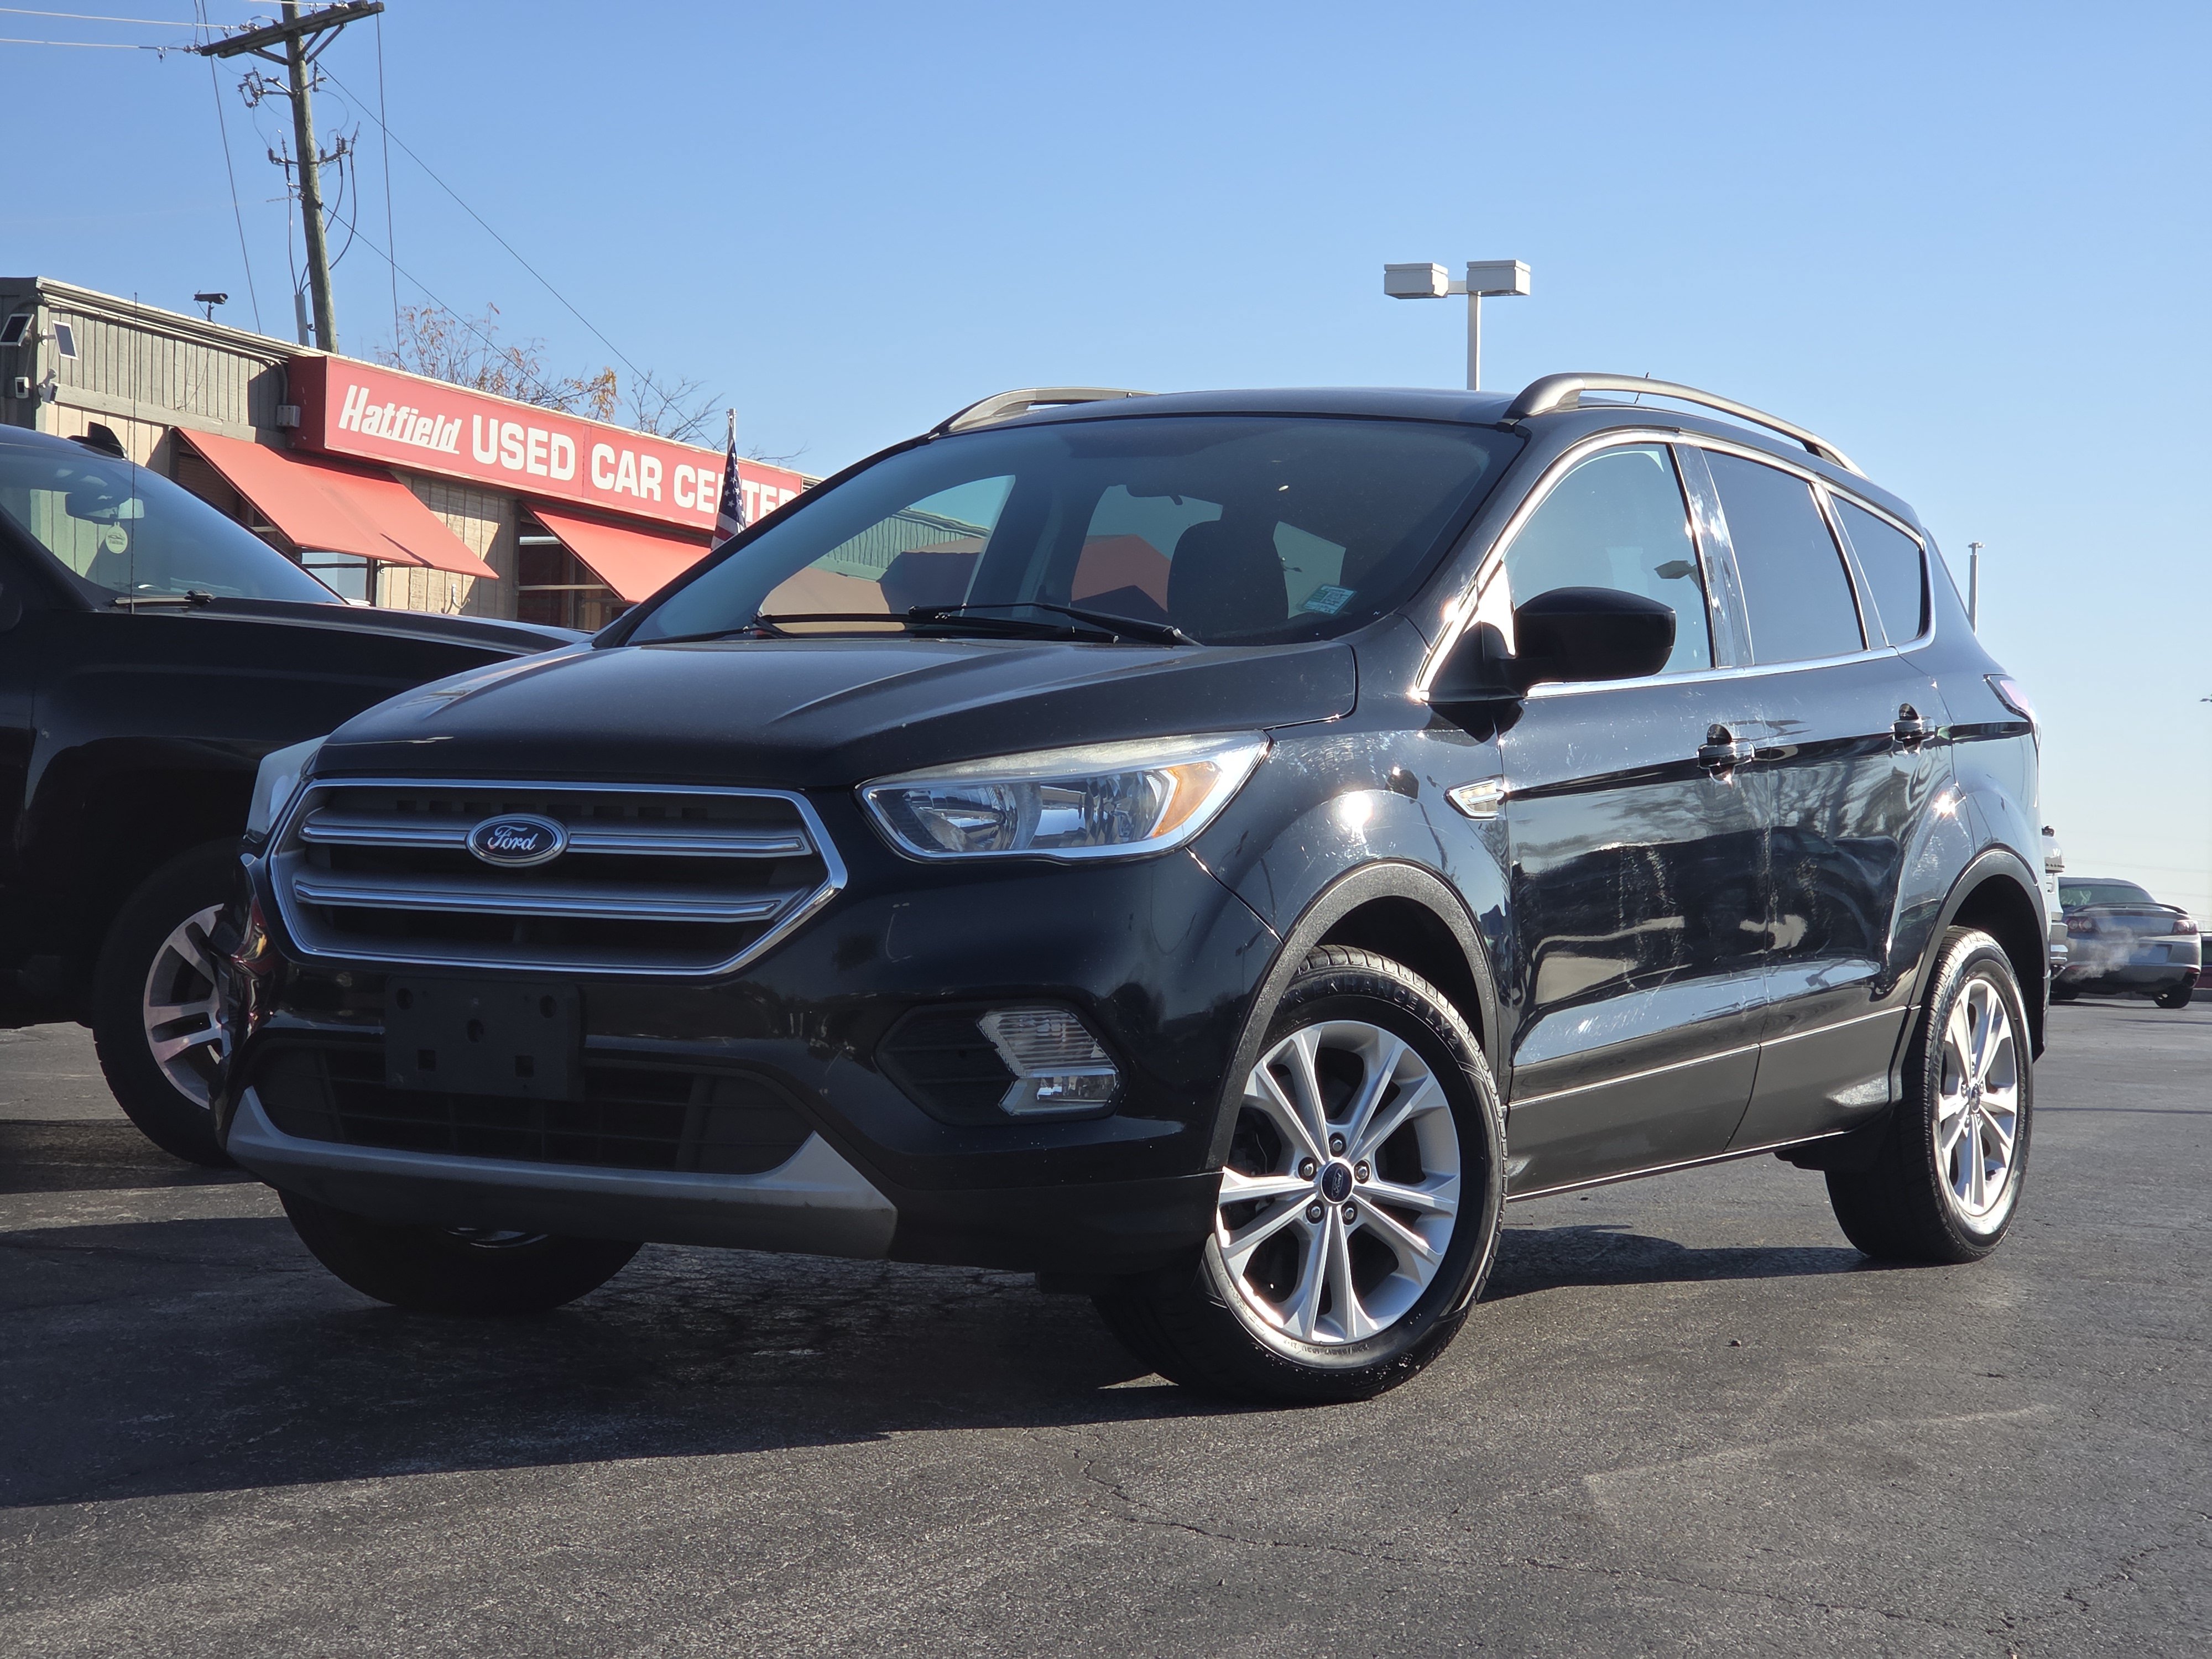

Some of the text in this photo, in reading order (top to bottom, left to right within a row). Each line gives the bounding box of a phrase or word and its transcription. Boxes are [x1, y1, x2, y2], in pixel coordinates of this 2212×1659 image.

[338, 384, 462, 455] Hatfield
[472, 414, 576, 481] USED
[591, 443, 662, 502] CAR
[487, 825, 539, 850] Ford
[1311, 973, 1420, 1011] ENHANCE
[1425, 1006, 1459, 1050] LX2
